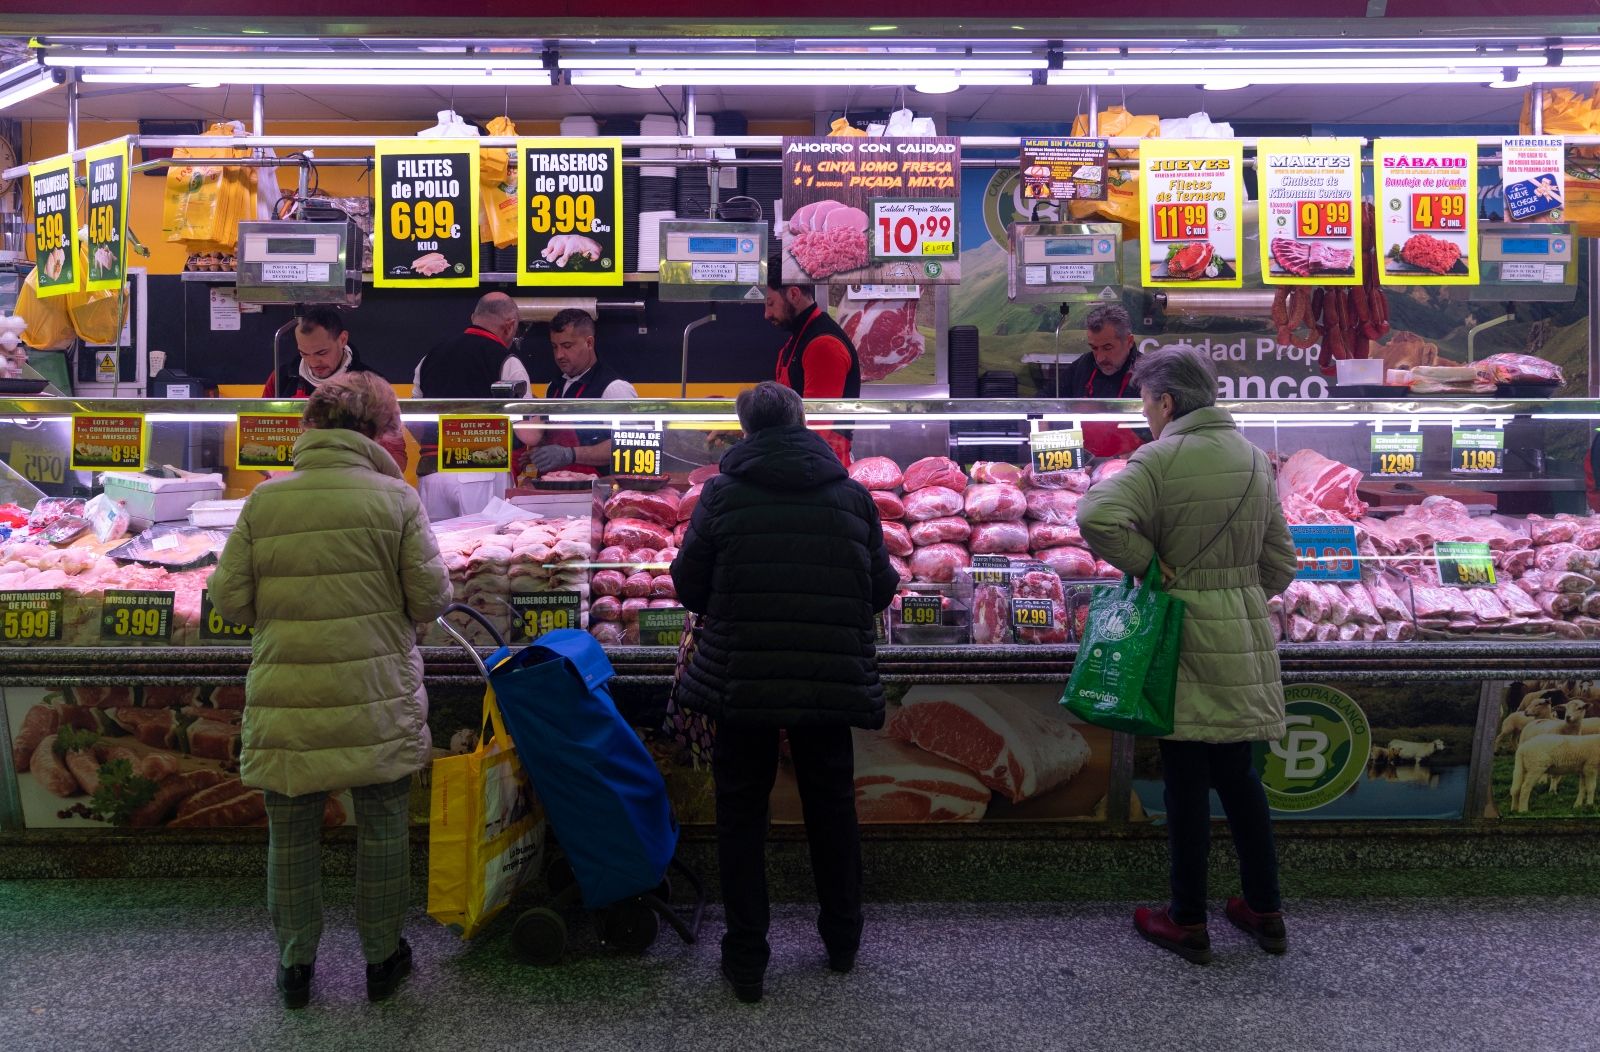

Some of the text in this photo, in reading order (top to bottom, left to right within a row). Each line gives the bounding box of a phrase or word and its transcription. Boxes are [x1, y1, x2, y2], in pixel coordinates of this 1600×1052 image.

[786, 143, 956, 154] AHORRO CON CALIDAD
[1504, 138, 1562, 147] MIÉRCOLES
[530, 153, 608, 172] TRASEROS
[1150, 159, 1231, 172] JUEVES
[1270, 155, 1350, 168] MARTES
[1383, 155, 1467, 168] SÁBADO
[94, 162, 115, 183] ALITAS
[397, 159, 453, 177] FILETES
[794, 161, 952, 175] 1 CINTA LOMO FRESCA
[535, 174, 603, 193] de POLLO
[805, 176, 814, 187] 1
[849, 176, 903, 190] PICADA
[907, 176, 955, 190] MIXTA
[1169, 179, 1213, 191] Filetes
[1326, 175, 1339, 187] de
[1423, 178, 1434, 187] de
[1436, 177, 1467, 189] picada
[91, 182, 118, 203] de POLLO
[391, 179, 459, 198] de POLLO
[1507, 189, 1530, 200] VUELVE
[1156, 191, 1226, 202] de Ternera
[1510, 195, 1539, 209] EL CHEQUE
[37, 193, 66, 215] de POLLO
[879, 204, 952, 216] Calidad Propia Blanco
[1513, 205, 1536, 217] REGALO
[1193, 227, 1206, 235] KILO
[1333, 226, 1347, 234] KILO
[417, 241, 438, 251] KILO
[614, 431, 661, 440] AGUJA DE
[614, 439, 660, 447] TERNERA
[0, 592, 62, 601] ONTRAMUSLOS
[105, 596, 172, 605] MUSLOS DE POLLO
[512, 595, 579, 605] TRASEROS DE POLLO
[8, 601, 47, 610] DE POLLO
[1078, 689, 1119, 703] ecovidrio
[1283, 687, 1366, 735] PROPIA BLANCO
